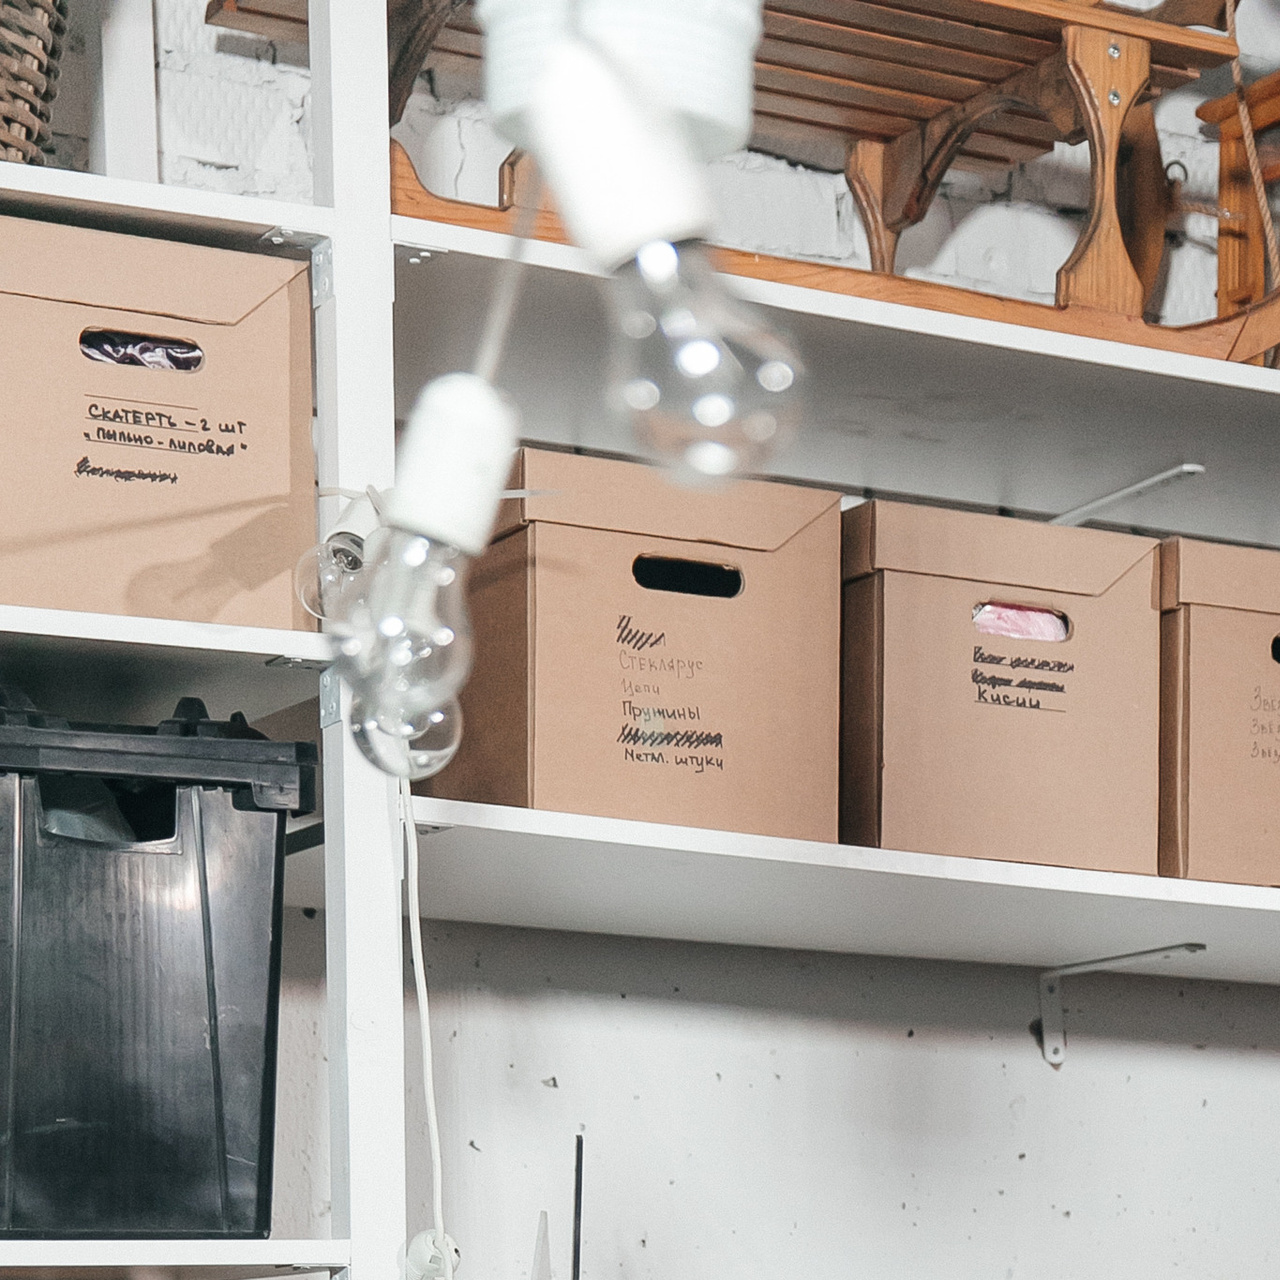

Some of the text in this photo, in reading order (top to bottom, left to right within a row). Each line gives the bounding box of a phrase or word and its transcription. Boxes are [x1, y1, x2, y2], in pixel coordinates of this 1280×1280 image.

[88, 403, 178, 428] СКАТЕРТЬ
[200, 418, 211, 432] 2
[620, 678, 661, 697] Цепи
[622, 700, 701, 722] Пружины
[674, 754, 724, 774] штуки
